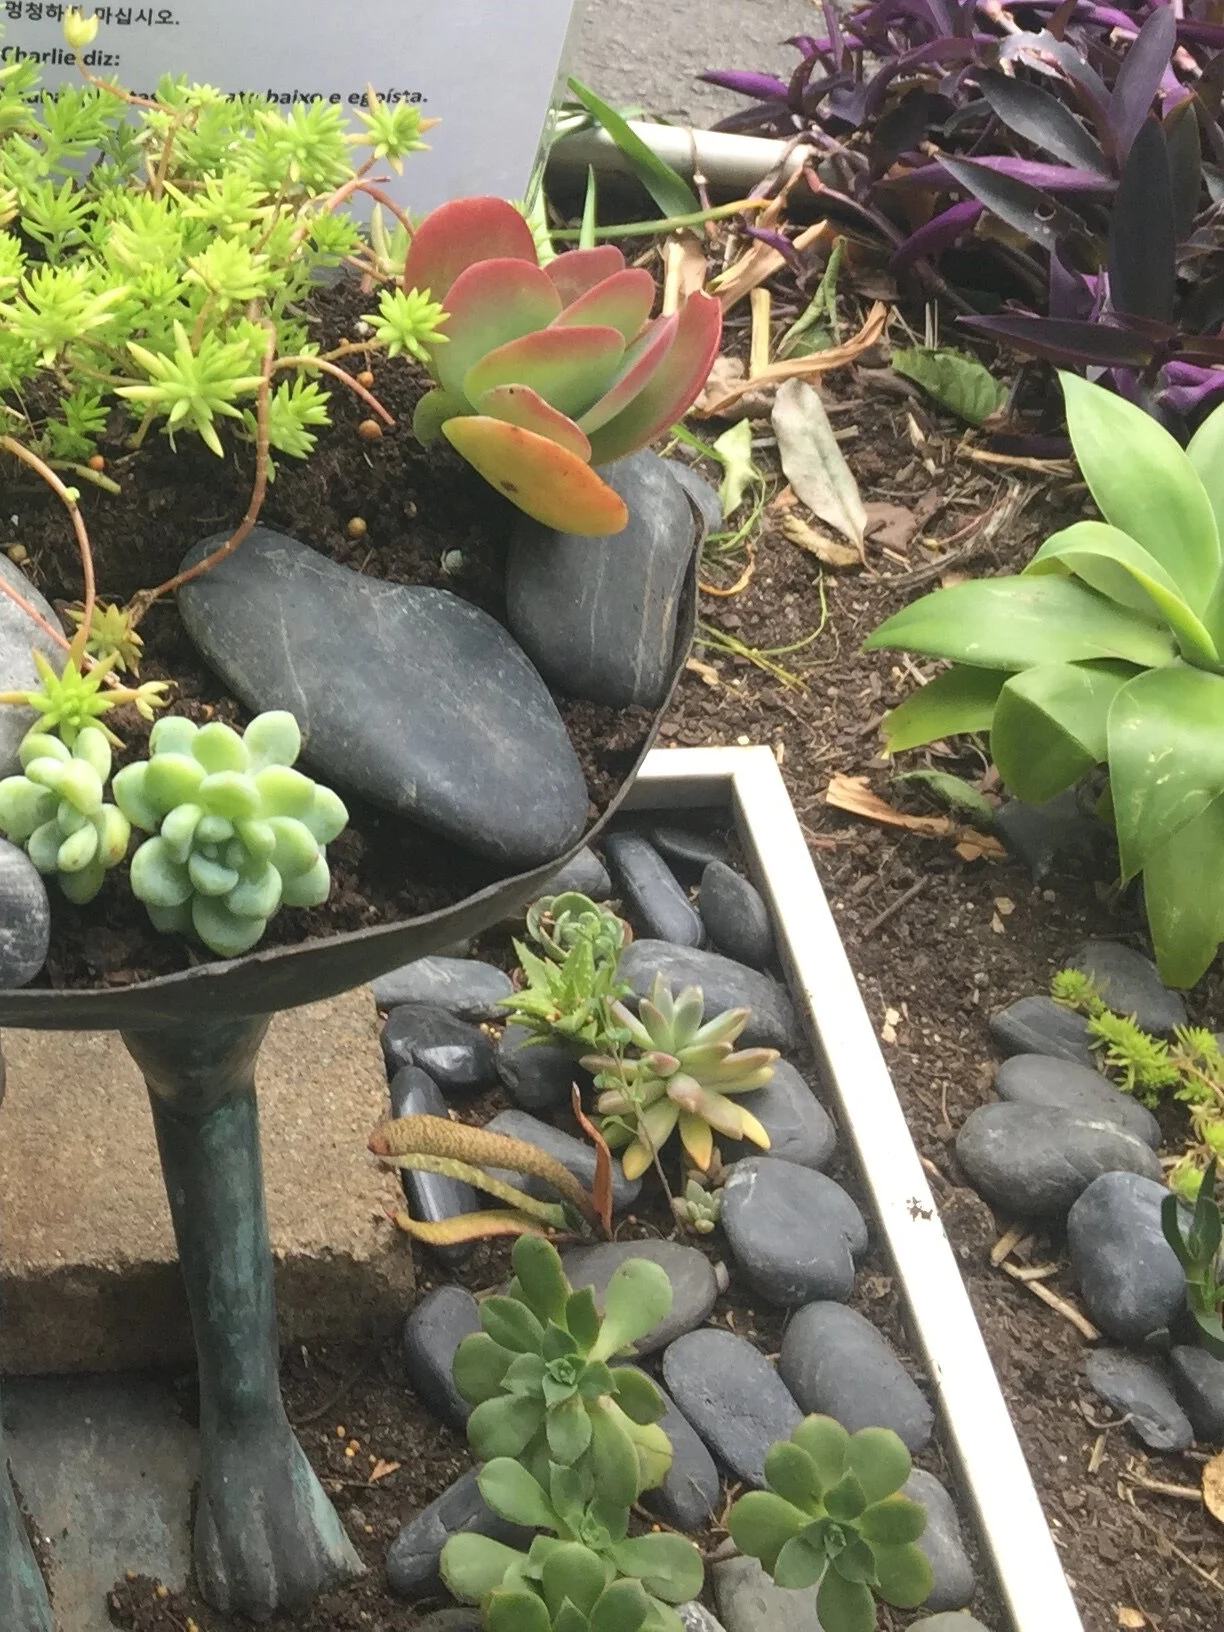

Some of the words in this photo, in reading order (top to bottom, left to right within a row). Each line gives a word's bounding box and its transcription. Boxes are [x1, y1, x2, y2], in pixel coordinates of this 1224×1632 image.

[94, 6, 180, 27] 마십시오.
[0, 45, 77, 67] Charlie
[83, 50, 121, 67] diz:
[328, 92, 342, 105] e
